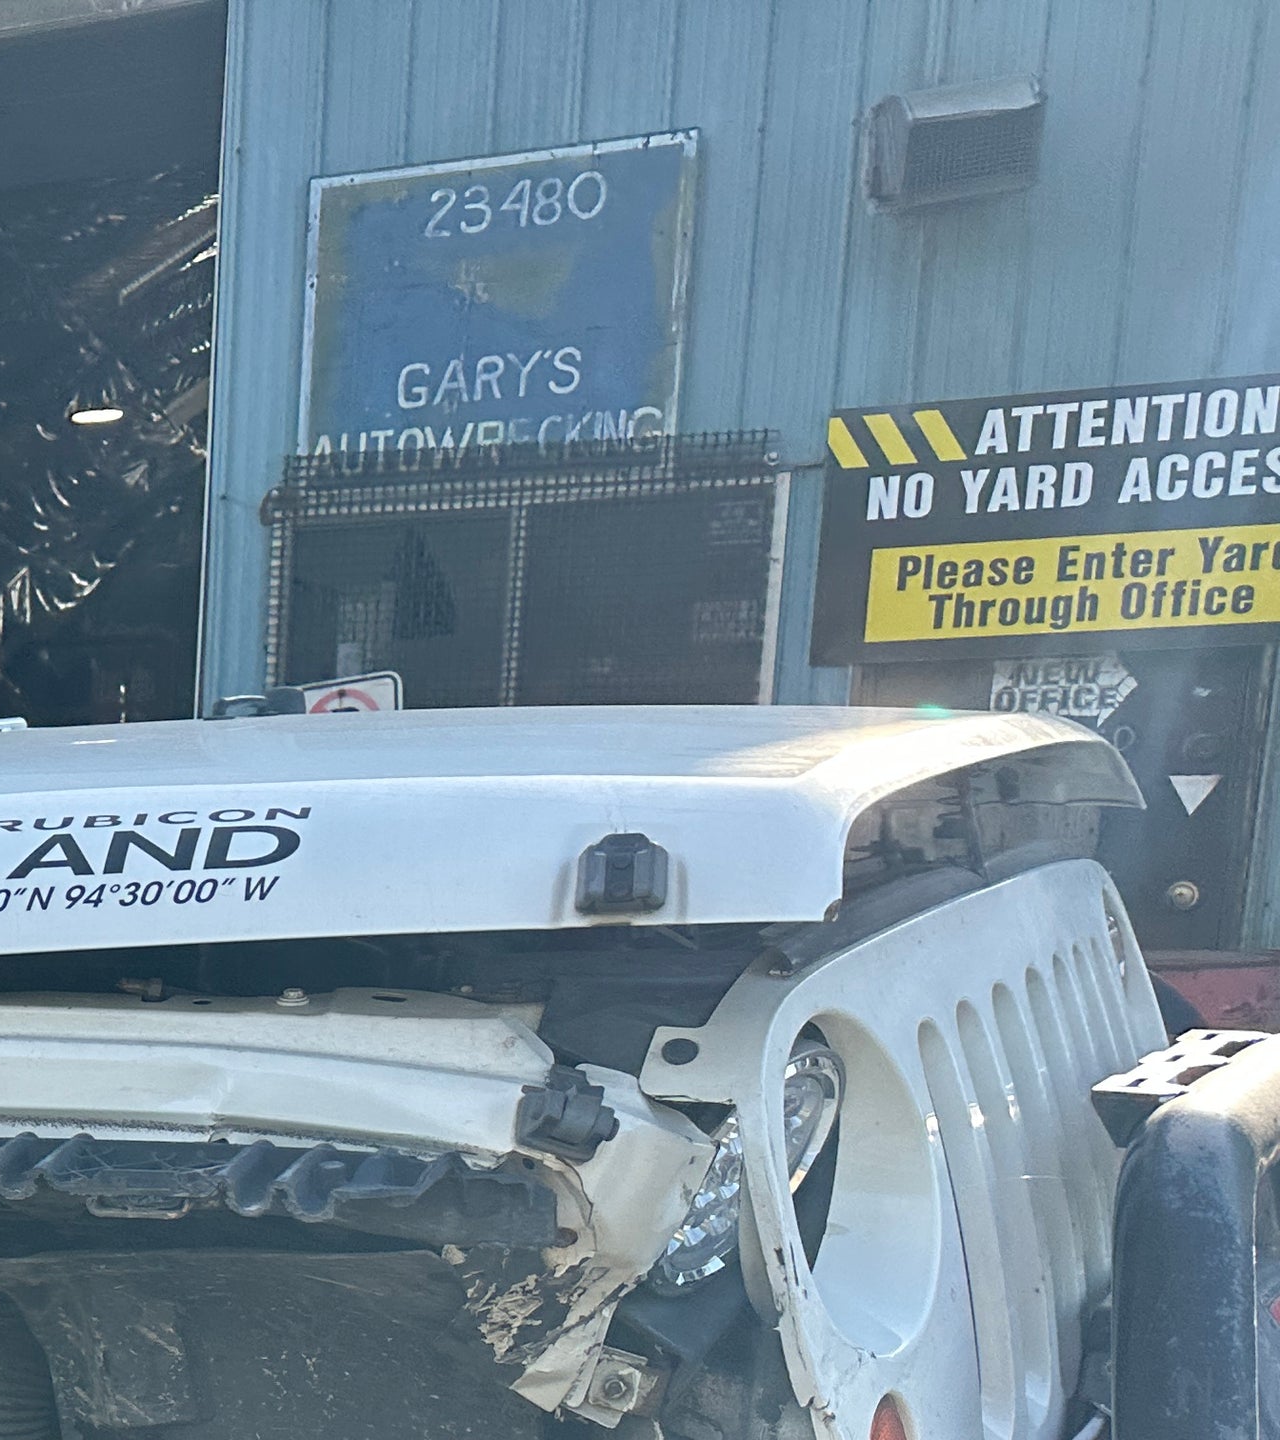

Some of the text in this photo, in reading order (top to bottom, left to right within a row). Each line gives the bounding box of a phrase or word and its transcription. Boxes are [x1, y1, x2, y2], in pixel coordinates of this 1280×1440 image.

[424, 170, 608, 239] 23480
[396, 346, 583, 411] GARY'S
[974, 385, 1280, 456] ATTENTION
[866, 472, 935, 521] NO
[960, 461, 1094, 514] YARD
[896, 553, 1036, 592] Please
[1056, 542, 1176, 582] Enter
[928, 579, 1256, 631] Through Office
[243, 876, 281, 902] W
